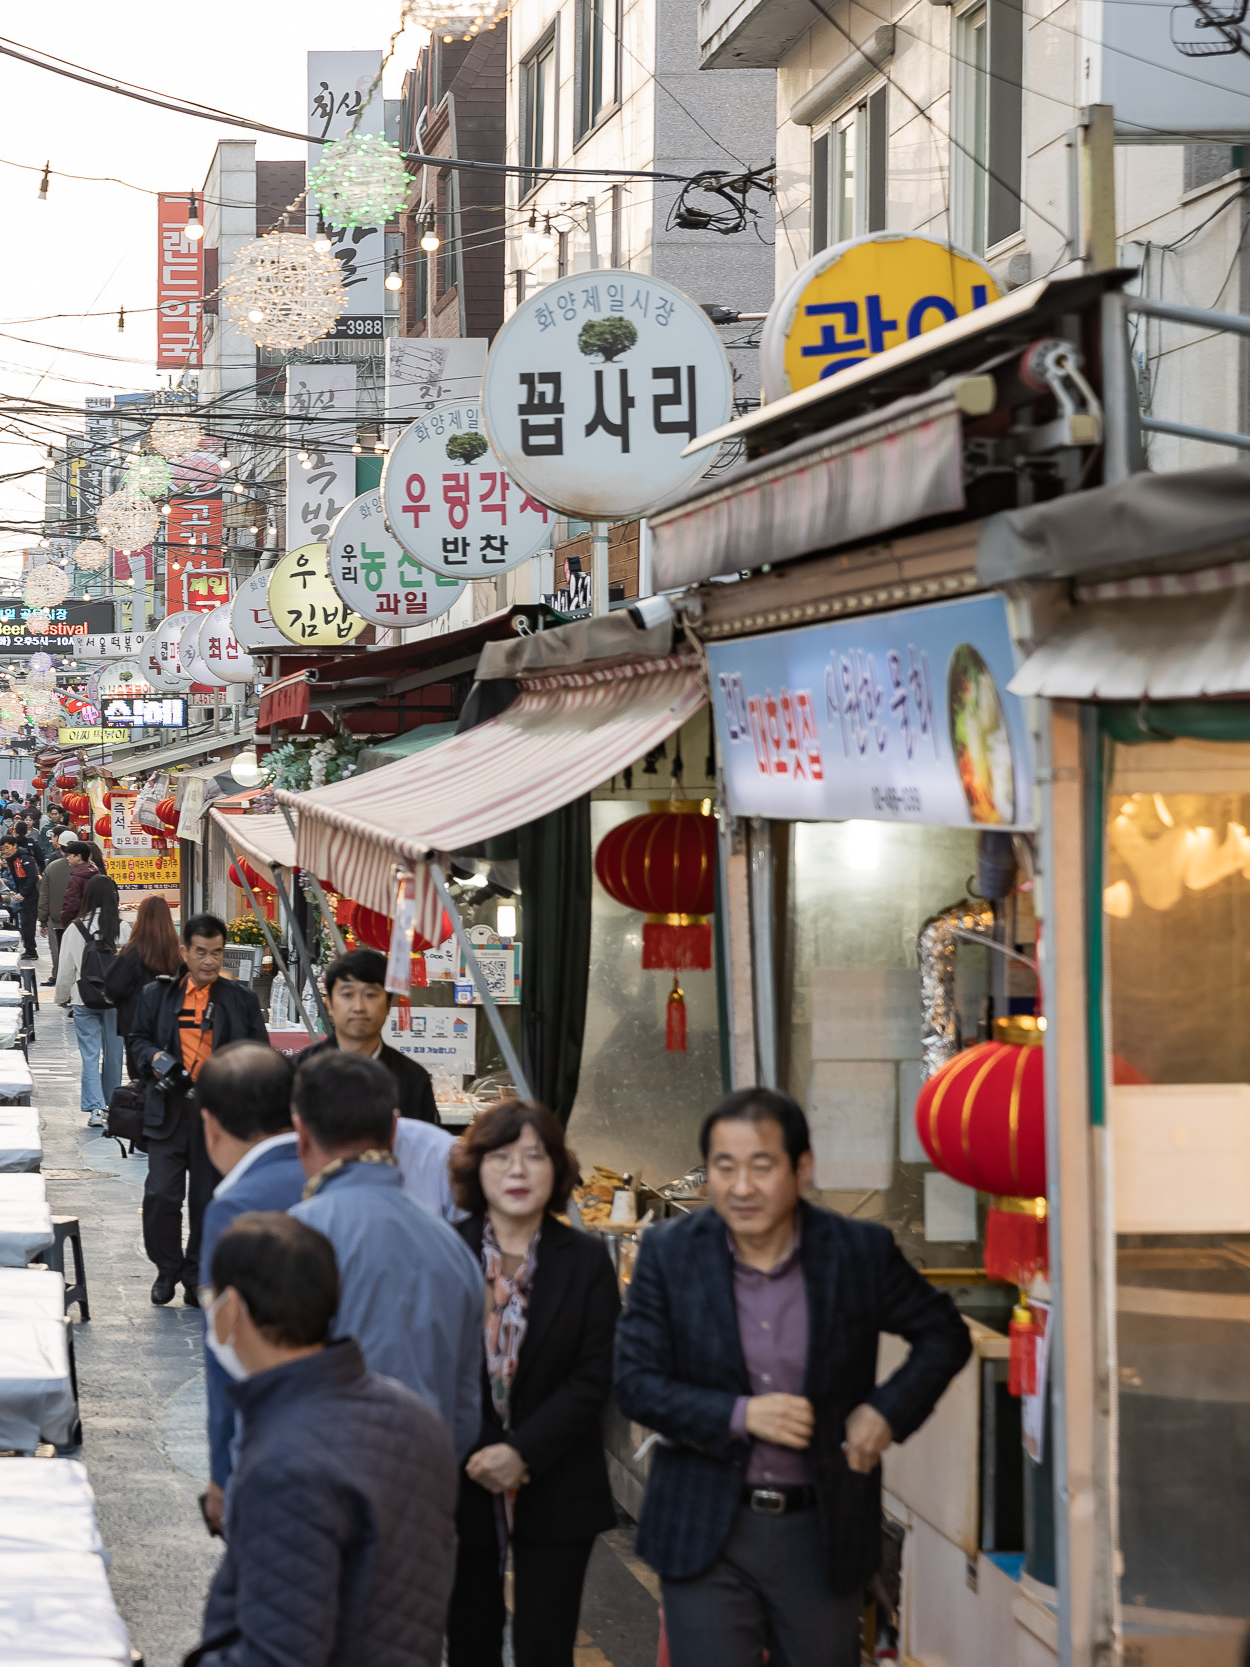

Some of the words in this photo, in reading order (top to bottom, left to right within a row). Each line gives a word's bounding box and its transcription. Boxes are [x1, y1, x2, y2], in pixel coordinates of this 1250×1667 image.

[534, 284, 677, 333] 화양제일시장
[517, 365, 700, 457] 꼽사리
[441, 534, 509, 566] 반찬
[286, 603, 354, 639] 김밥
[375, 591, 428, 616] 과일
